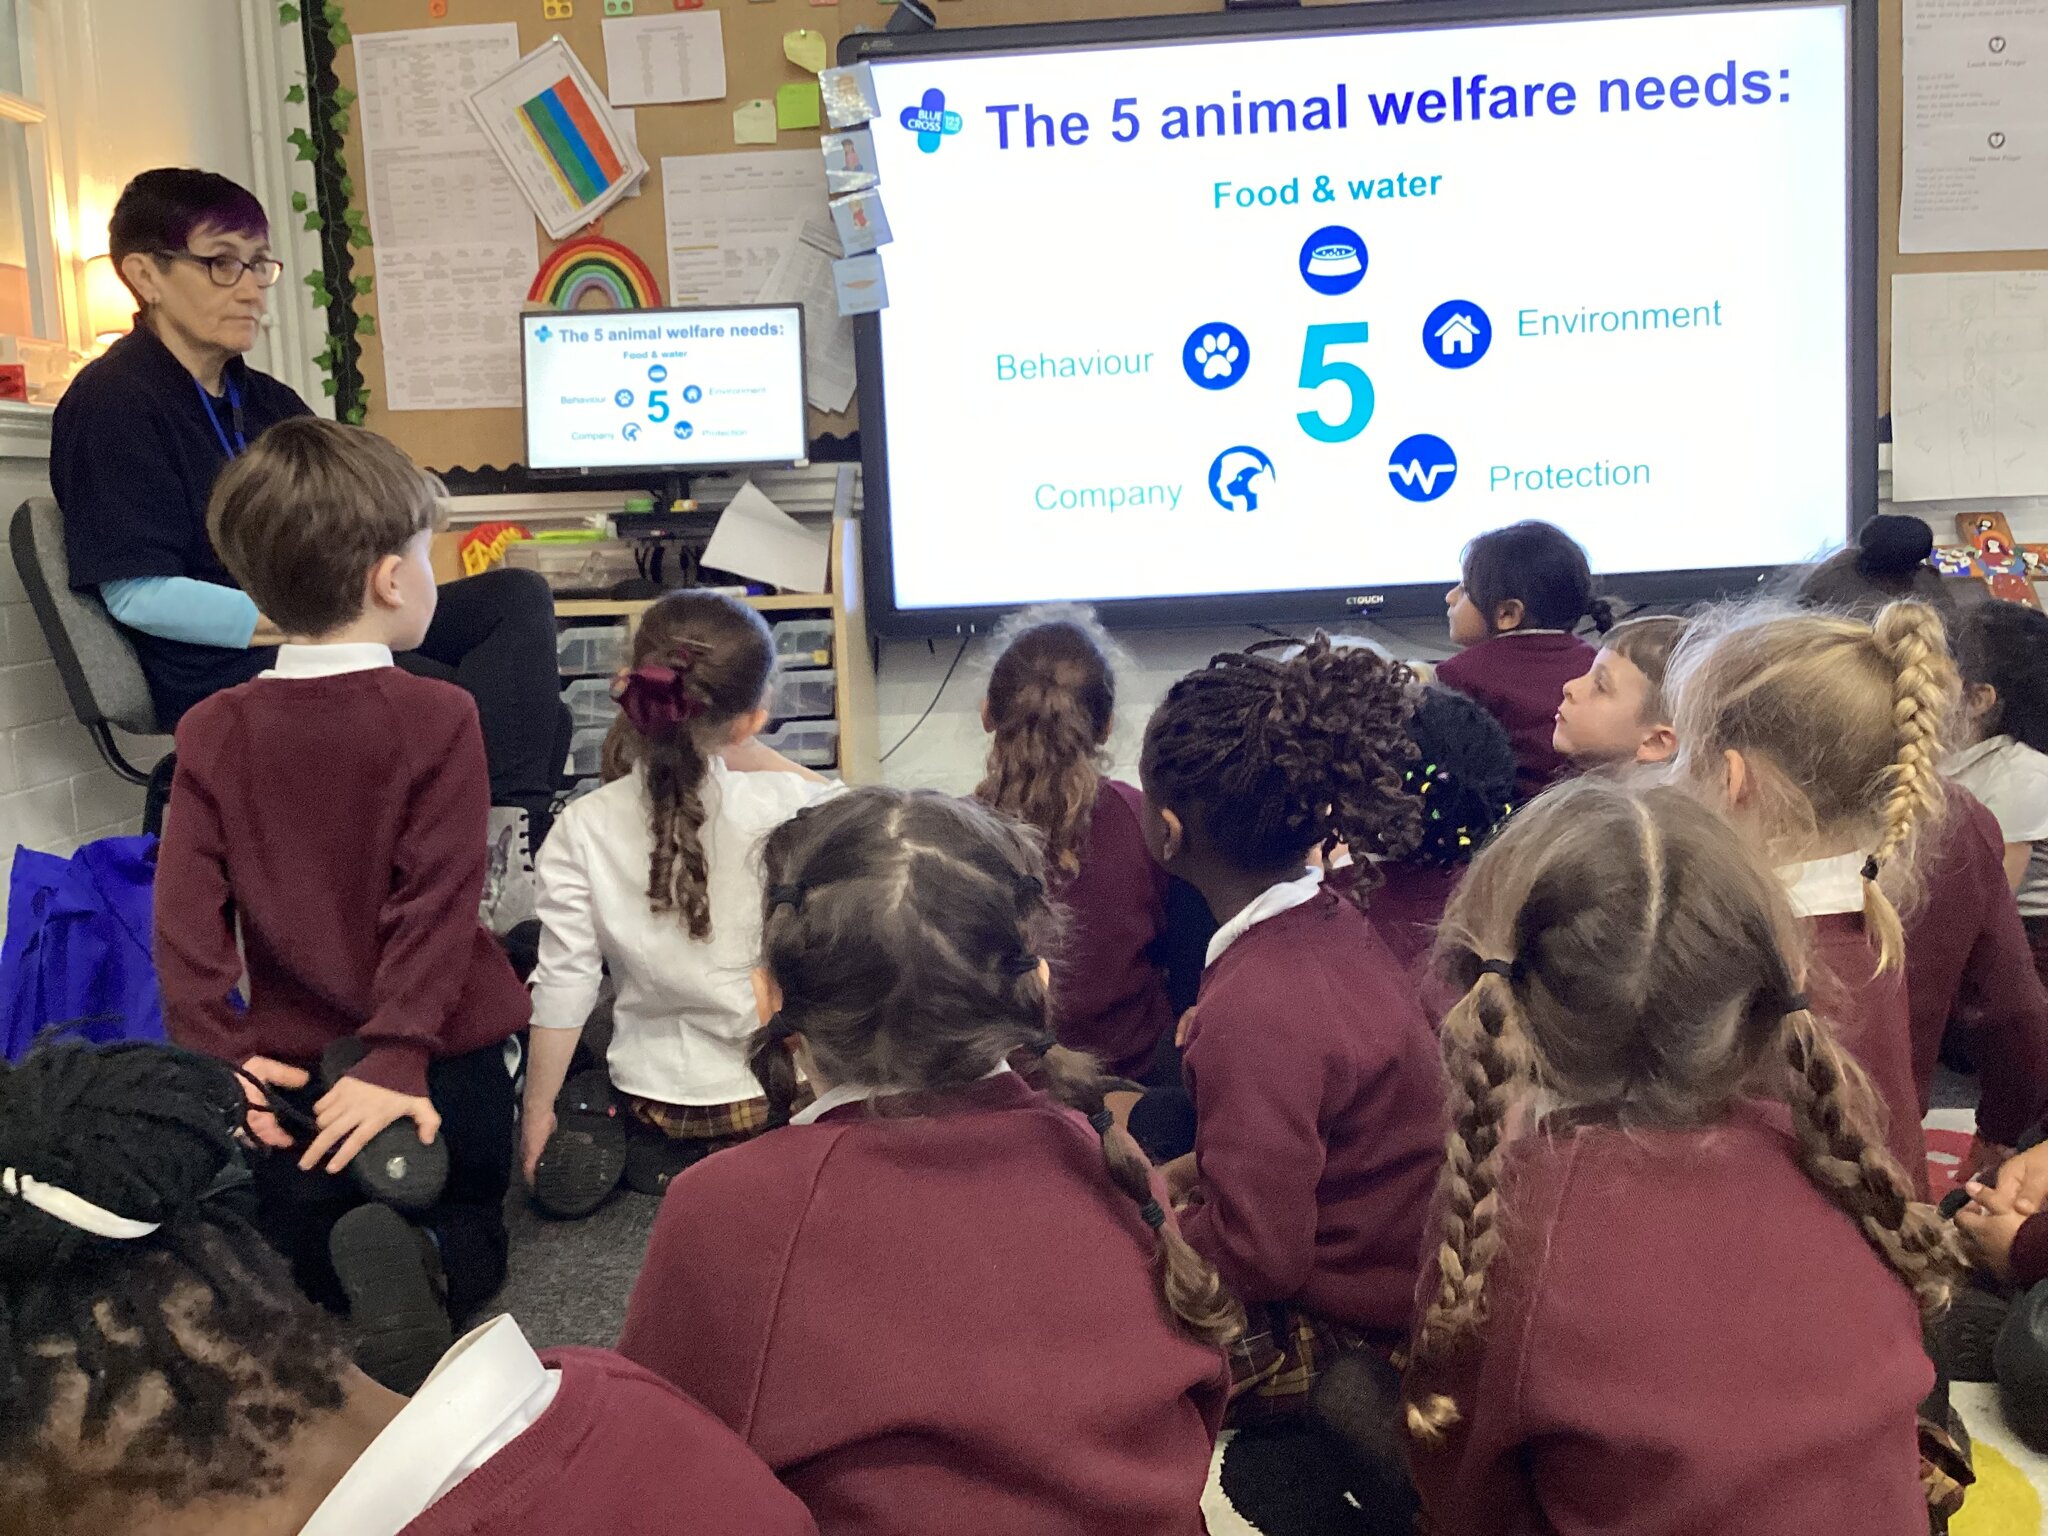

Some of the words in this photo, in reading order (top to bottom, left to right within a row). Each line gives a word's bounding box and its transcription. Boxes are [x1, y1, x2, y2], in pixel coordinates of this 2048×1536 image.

[918, 109, 943, 121] BLUE
[985, 102, 1090, 150] The
[1111, 97, 1141, 143] 5
[1160, 82, 1348, 141] animal
[1367, 73, 1577, 127] welfare
[1599, 59, 1790, 113] needs:
[907, 118, 941, 132] CROSS
[1213, 176, 1299, 209] Food
[1312, 174, 1336, 204] &
[1347, 171, 1443, 201] water
[559, 329, 590, 343] The
[594, 328, 604, 342] 5
[608, 326, 662, 342] animal
[666, 324, 725, 339] welfare
[730, 322, 784, 337] needs:
[1517, 299, 1723, 337] Environment
[623, 351, 649, 360] Food
[651, 350, 658, 359] &
[661, 350, 688, 358] water
[996, 349, 1155, 382] Behaviour
[1296, 321, 1376, 444] 5
[647, 389, 670, 424] 5
[1488, 458, 1651, 493] Protection
[1033, 482, 1183, 514] Company
[1345, 594, 1384, 605] CTOUCH
